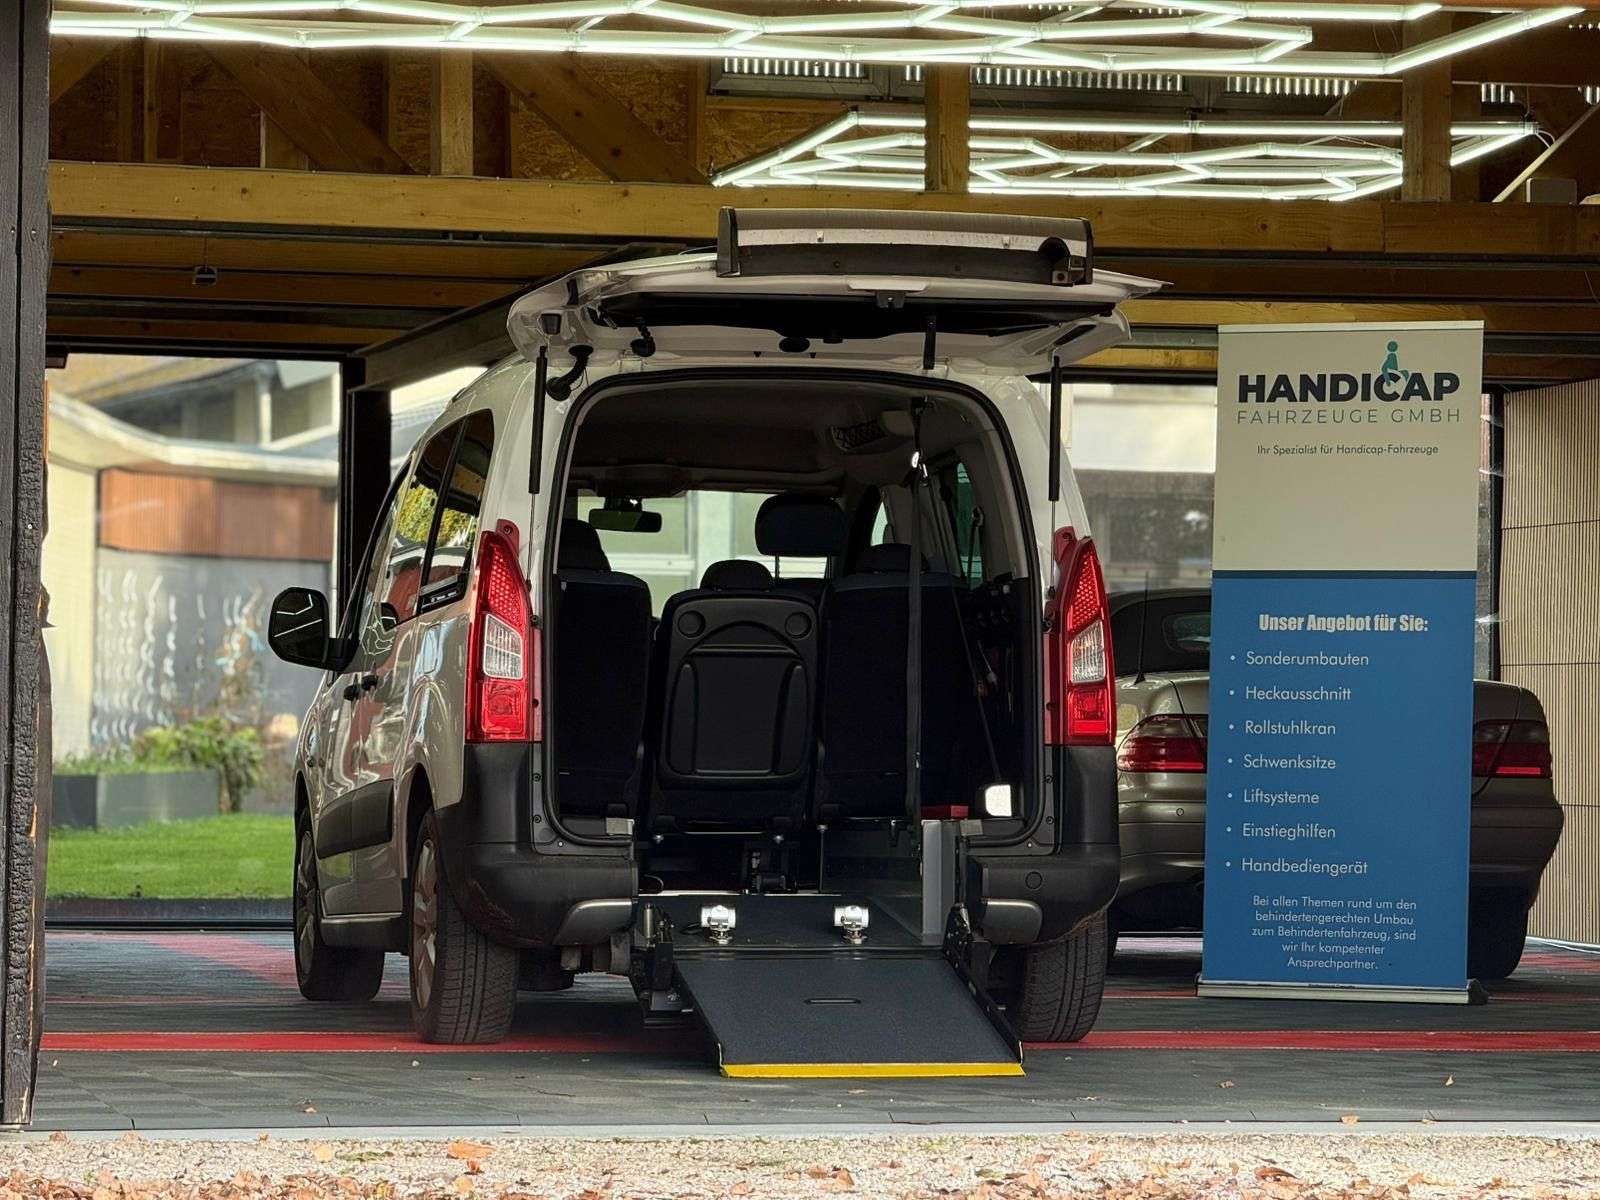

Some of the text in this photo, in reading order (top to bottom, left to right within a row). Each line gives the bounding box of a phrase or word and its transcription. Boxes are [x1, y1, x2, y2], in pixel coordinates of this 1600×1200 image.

[1238, 373, 1460, 403] HANDICAP
[1237, 408, 1460, 425] FAHRZEUGE GMBH
[1257, 444, 1439, 456] Ihr Spezialist für Handicap-Fahrzeuge
[1259, 614, 1428, 633] Unser Angebot für Sie:
[1246, 651, 1369, 666] Sonderumbauten
[1246, 686, 1351, 701] Heckausschnitt
[1245, 720, 1336, 735] Rollstuhlkran
[1243, 754, 1336, 769] Schwenksitze
[1243, 788, 1320, 806] Liftsysteme
[1242, 823, 1336, 840] Einstieghilfen
[1241, 858, 1368, 877] Handbediengerät
[1253, 895, 1417, 910] Bei allen Themen rund um den
[1255, 910, 1414, 925] behindertengerechten Umbau
[1251, 925, 1416, 942] zum Behindertenfahrzeug, sind
[1281, 941, 1385, 956] wir Ihr kompetenter
[1287, 956, 1379, 971] Ansprechpartner.
